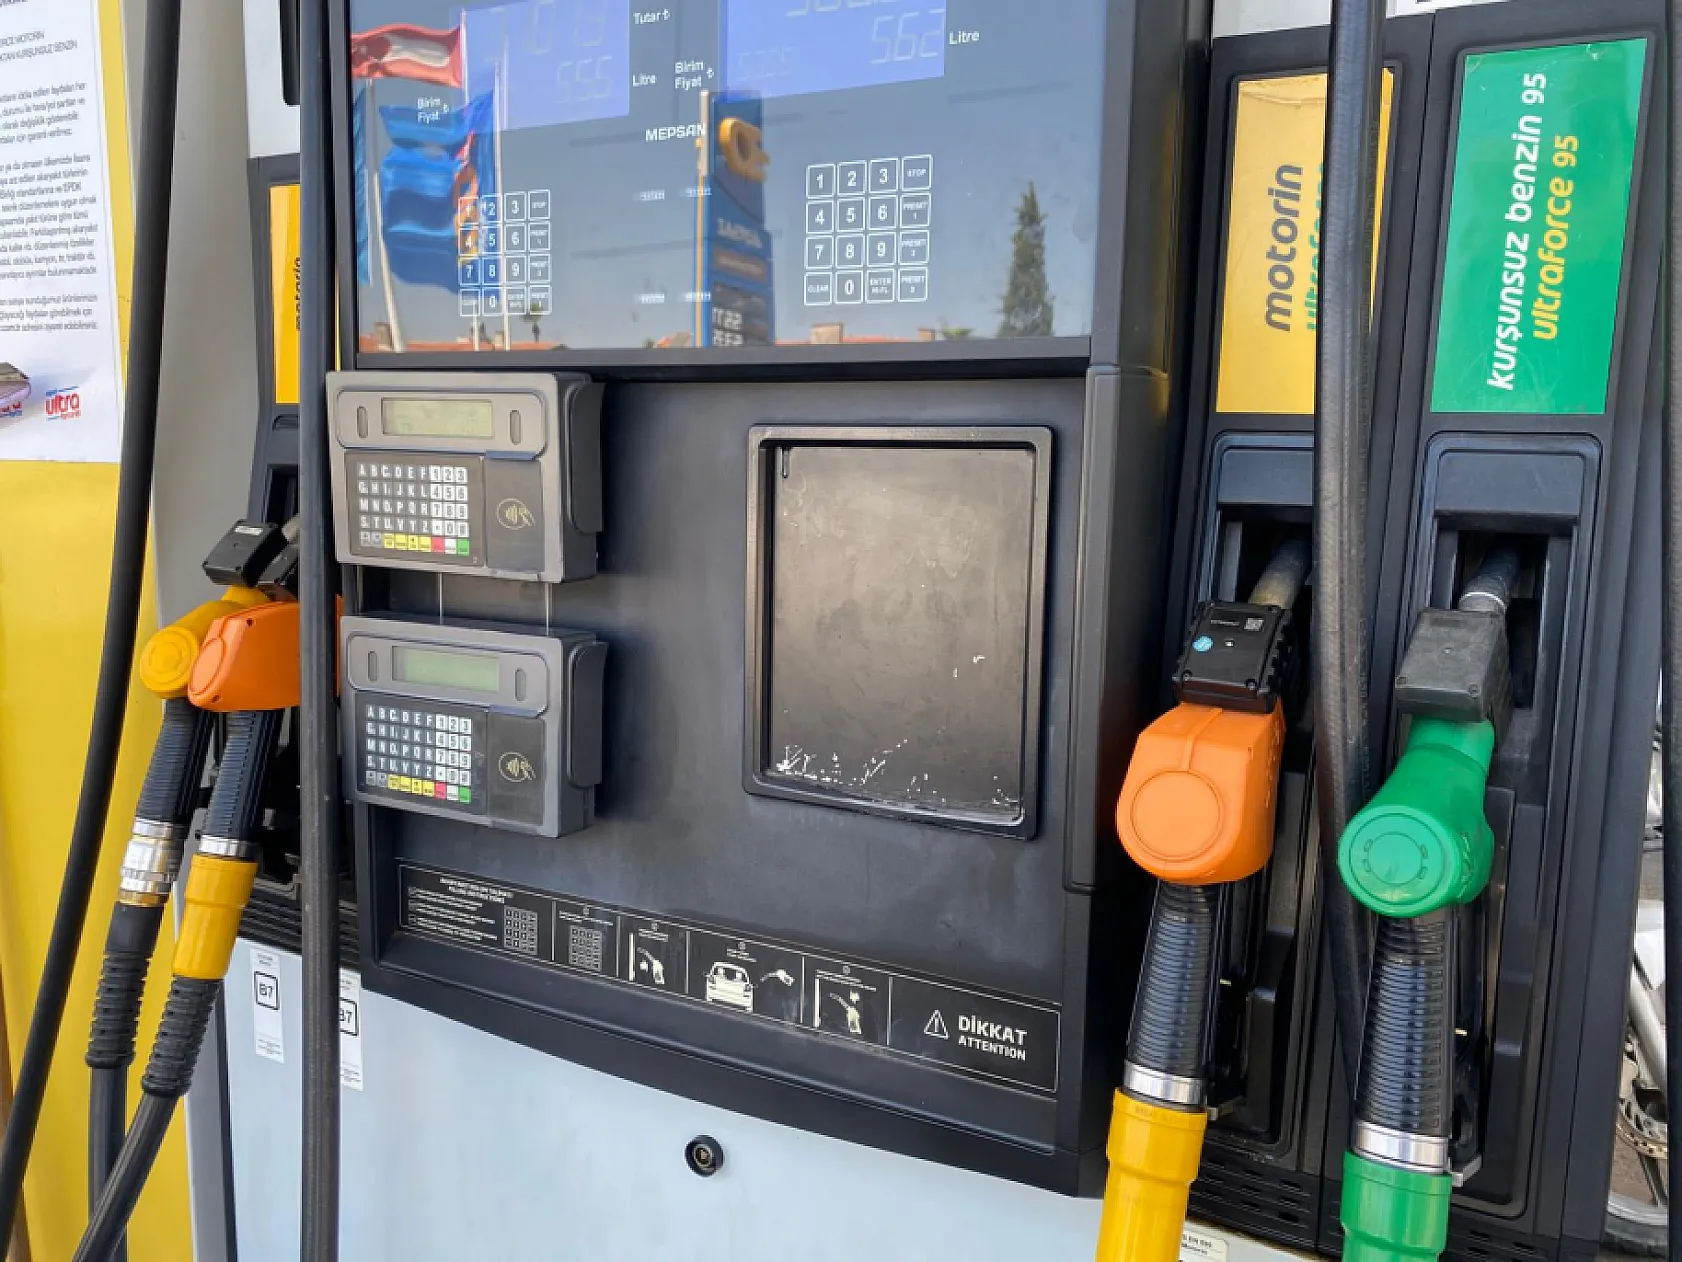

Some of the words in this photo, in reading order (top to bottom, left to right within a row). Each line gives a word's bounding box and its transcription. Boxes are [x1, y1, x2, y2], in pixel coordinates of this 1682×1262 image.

[633, 11, 660, 24] Tutar
[949, 30, 979, 44] Litre
[675, 60, 704, 74] Birim
[633, 74, 657, 87] Litre
[675, 76, 701, 90] Fiyat
[1522, 73, 1546, 104] 95
[646, 123, 706, 142] MEPSAN
[1505, 114, 1542, 222] benzin
[816, 172, 824, 189] 1
[848, 171, 856, 186] 2
[880, 168, 888, 184] 3
[512, 200, 519, 214] 3
[815, 209, 825, 225] 4
[846, 207, 856, 223] 5
[877, 204, 887, 221] 6
[489, 233, 496, 247] 5
[512, 231, 519, 245] 6
[1533, 177, 1574, 340] ultraforce
[1554, 135, 1578, 168] 95
[815, 244, 824, 261] 7
[846, 243, 855, 259] 8
[877, 241, 886, 257] 9
[1266, 164, 1303, 332] motorin
[512, 262, 519, 276] 9
[1487, 232, 1530, 390] kurşunsuz
[259, 983, 273, 999] B7
[958, 1014, 1028, 1046] DİKKAT
[958, 1036, 1027, 1061] ATTENTION
